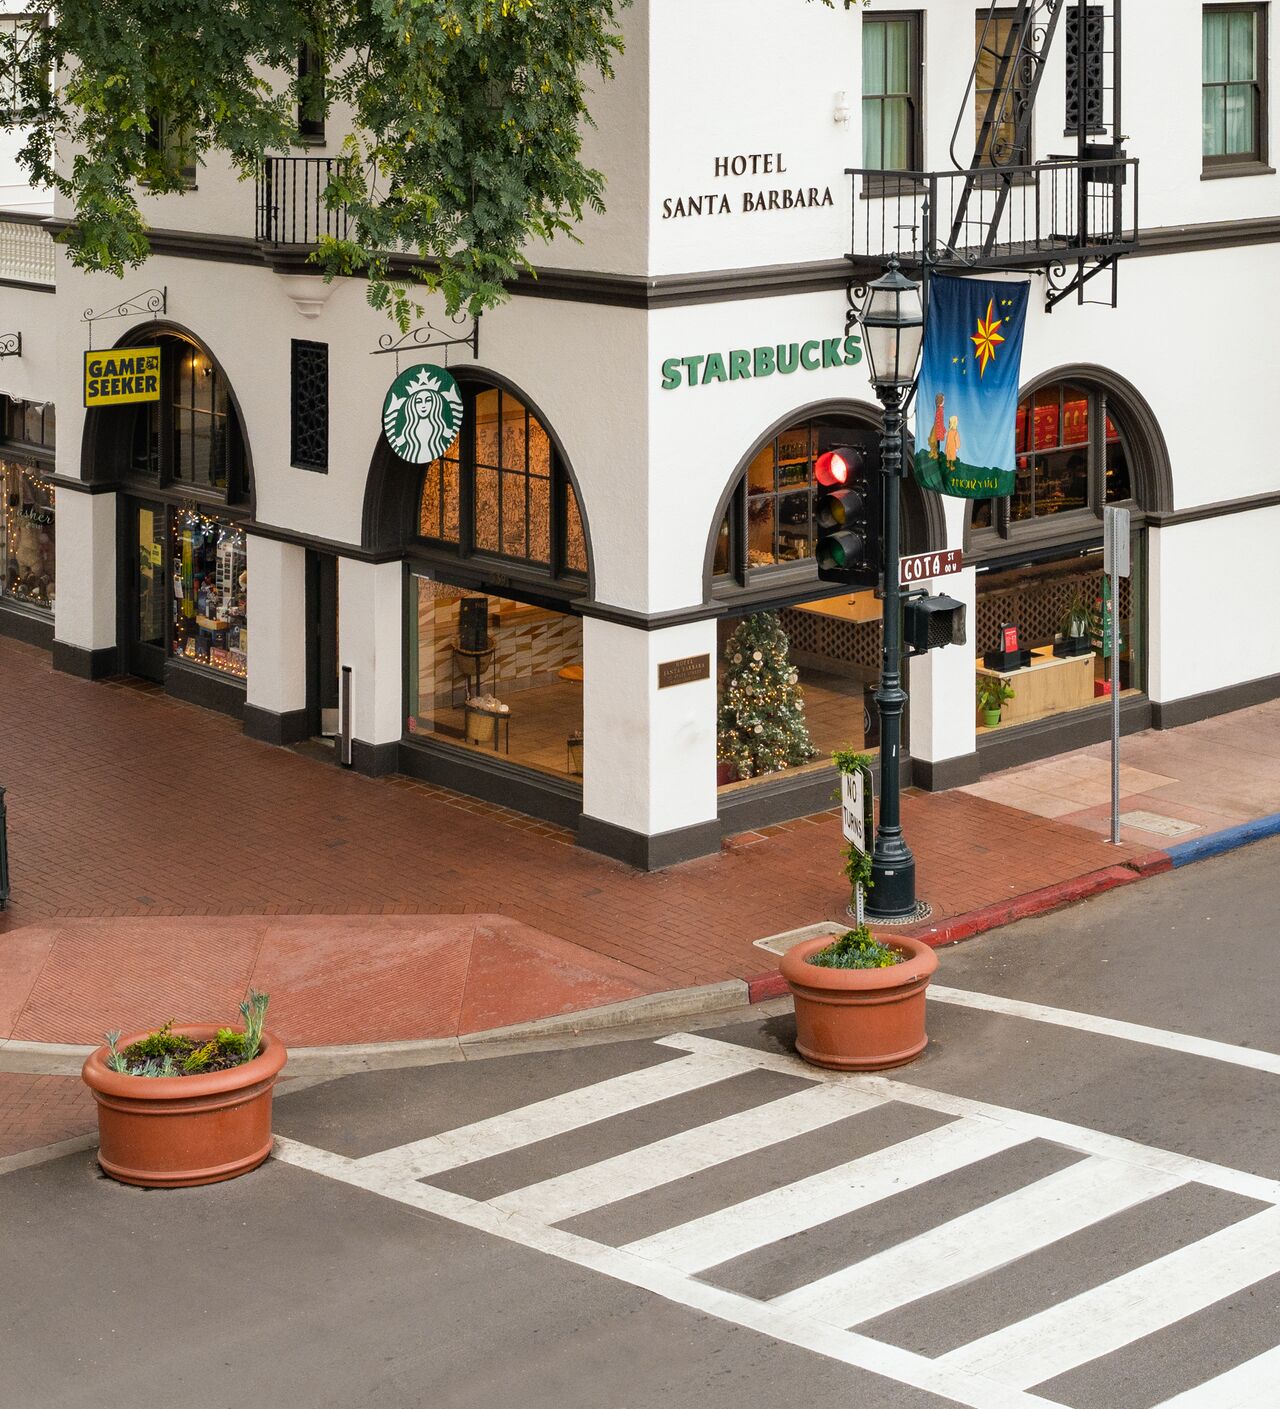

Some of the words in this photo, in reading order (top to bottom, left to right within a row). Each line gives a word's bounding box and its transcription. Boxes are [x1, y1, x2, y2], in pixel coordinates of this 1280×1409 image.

[714, 153, 787, 177] HOTEL
[662, 193, 732, 219] SANTA
[742, 186, 834, 212] BARBARA
[88, 357, 146, 378] GAME
[661, 335, 863, 390] STARBUCKS
[88, 375, 157, 398] SEEKER
[905, 555, 940, 580] COTA
[947, 552, 955, 561] ST
[847, 775, 857, 803] NO
[844, 805, 862, 839] TURNS
